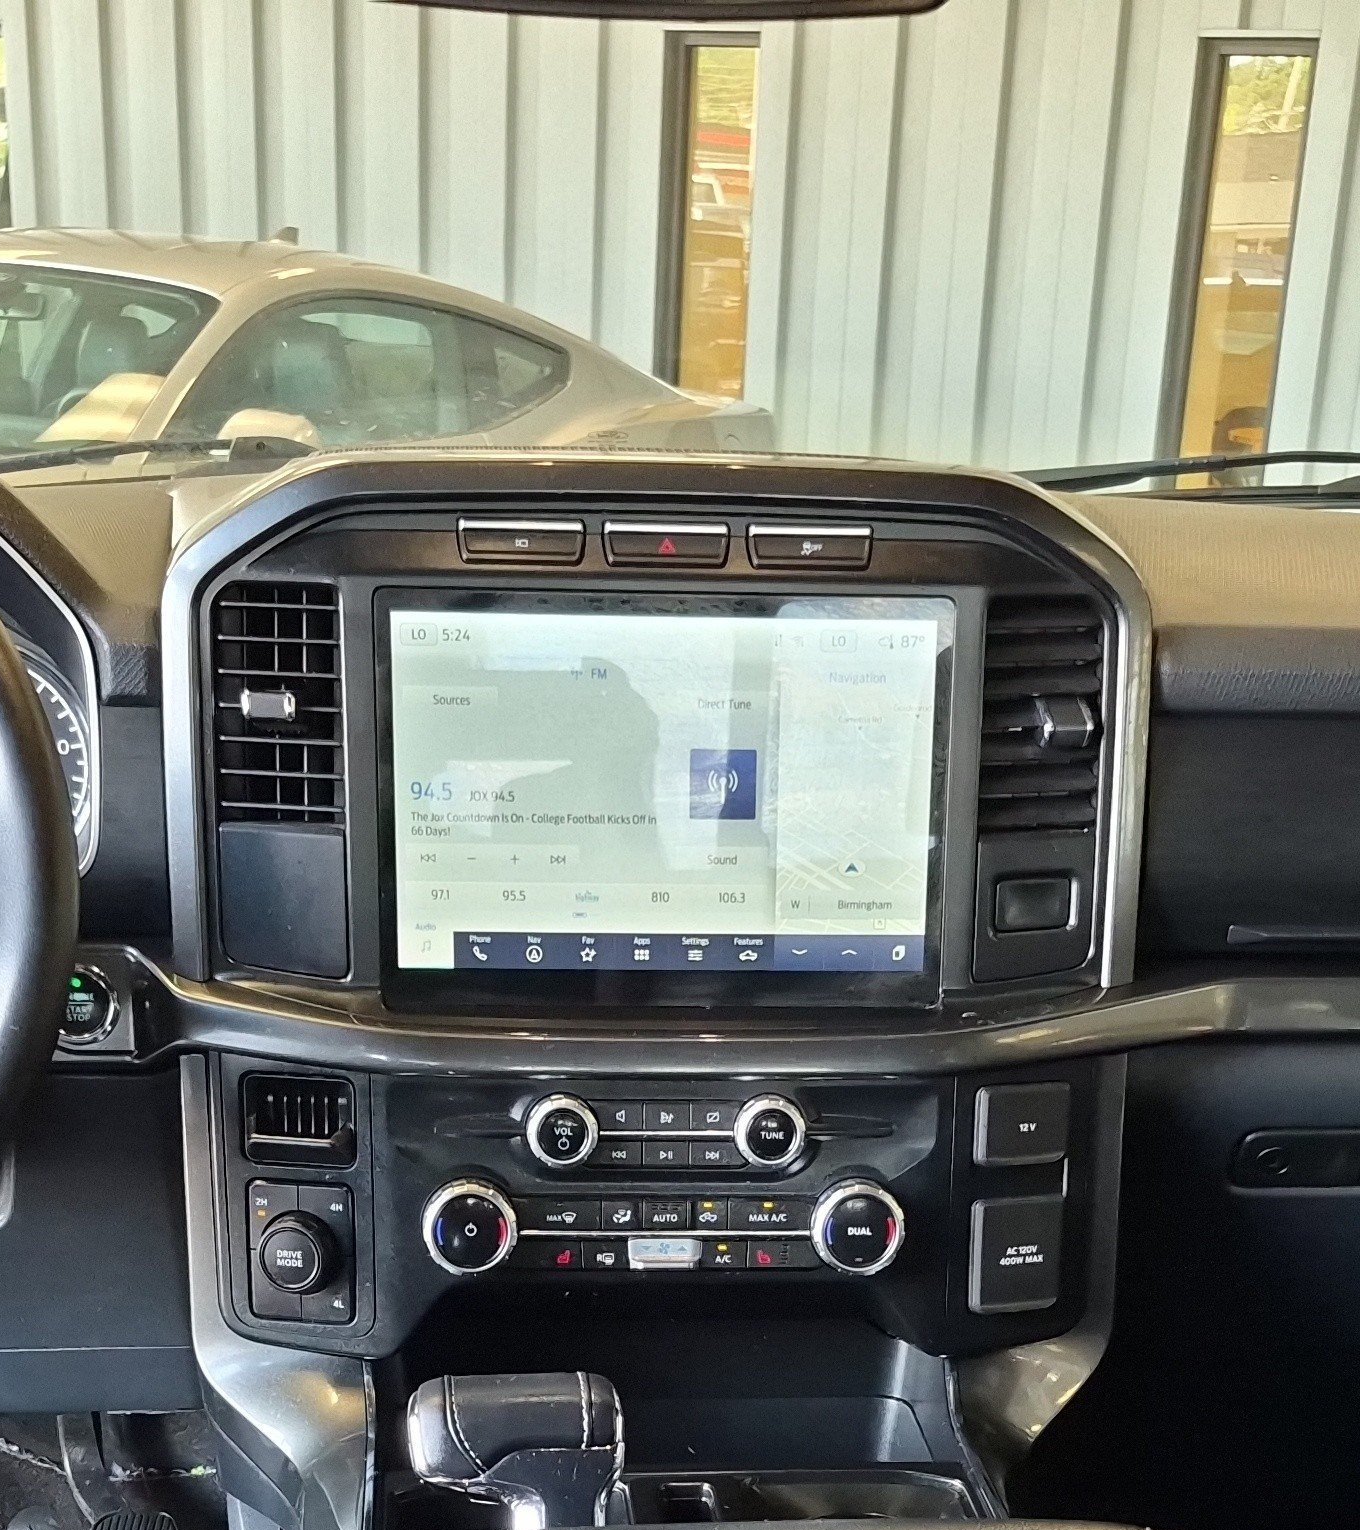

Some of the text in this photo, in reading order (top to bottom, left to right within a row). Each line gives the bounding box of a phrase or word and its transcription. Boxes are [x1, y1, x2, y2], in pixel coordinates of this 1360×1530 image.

[411, 629, 470, 642] LO 5:24
[831, 636, 846, 647] LO
[591, 669, 607, 680] FM
[829, 672, 887, 685] Navigation
[433, 694, 471, 706] Sources
[698, 699, 752, 710] Direct Tune
[410, 781, 515, 802] 94.5 JOX 94.5
[411, 812, 428, 822] The
[430, 813, 444, 822] Jox
[446, 813, 500, 823] Countdown
[511, 814, 524, 823] On
[531, 813, 566, 826] College
[567, 814, 605, 824] Football
[607, 814, 631, 825] Kicks
[632, 814, 647, 825] Off
[411, 826, 451, 837] 66 Days!
[707, 855, 737, 866] Sound
[431, 889, 745, 904] 97.1 95.5 810 106.3
[791, 900, 892, 911] W Birmingham
[415, 923, 436, 931] Audio
[469, 935, 491, 944] Phone
[528, 935, 541, 944] Nav
[582, 936, 595, 945] Fav
[634, 936, 650, 946] Apps
[681, 937, 709, 947] Settings
[733, 937, 763, 946] Features
[67, 1013, 91, 1021] STOP
[554, 1127, 573, 1136] VOL
[1019, 1123, 1029, 1132] 12
[760, 1131, 784, 1140] TUNE
[255, 1198, 268, 1206] 2H
[330, 1203, 343, 1212] 4H
[546, 1214, 562, 1222] MAX
[653, 1214, 678, 1223] AUTO
[749, 1213, 788, 1223] MAX A/C
[847, 1227, 872, 1236] DUAL
[277, 1249, 303, 1259] DRIVE
[1006, 1245, 1038, 1255] AC 120V
[277, 1259, 303, 1268] MODE
[715, 1255, 732, 1264] A/C
[999, 1254, 1043, 1265] 400W MAX
[333, 1300, 345, 1309] 4L
